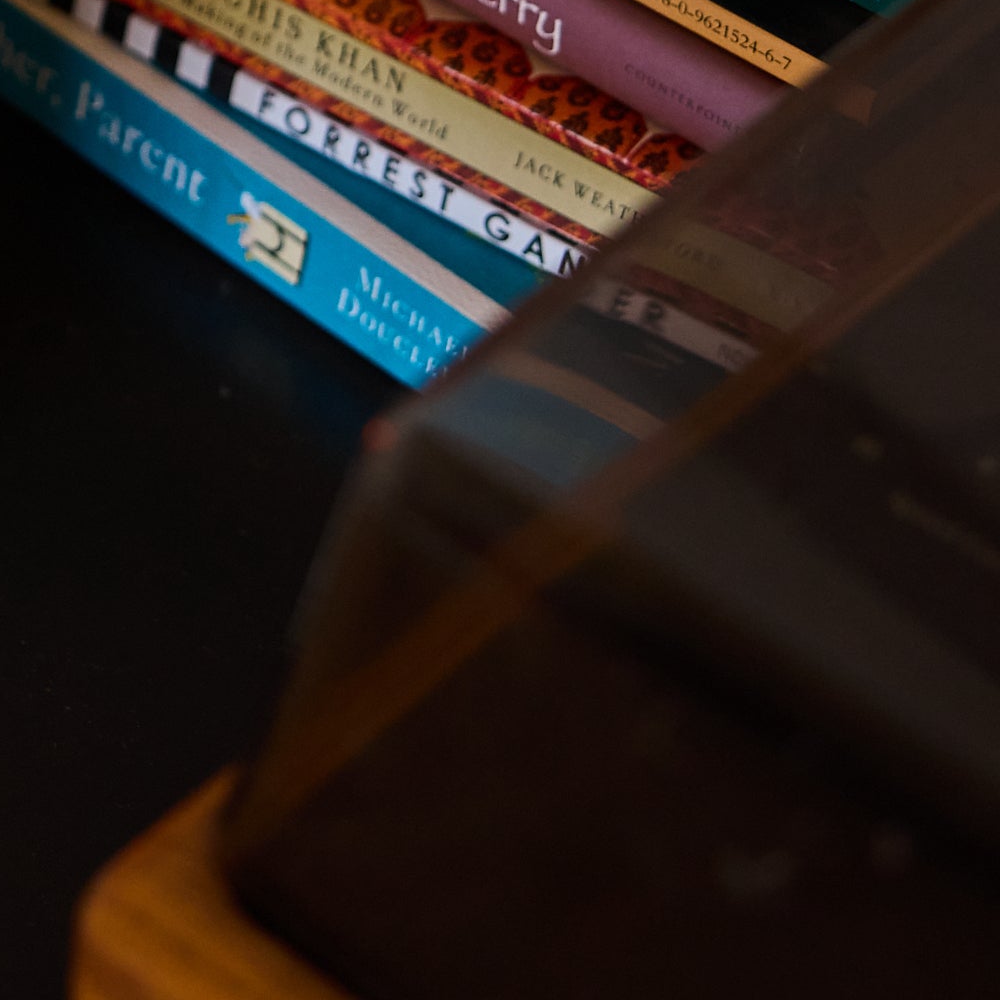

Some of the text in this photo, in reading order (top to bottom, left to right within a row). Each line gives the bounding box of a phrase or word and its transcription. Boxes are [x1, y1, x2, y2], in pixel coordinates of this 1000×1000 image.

[315, 29, 410, 95] KHAN
[256, 91, 460, 212] FORREST
[512, 150, 567, 188] JACK
